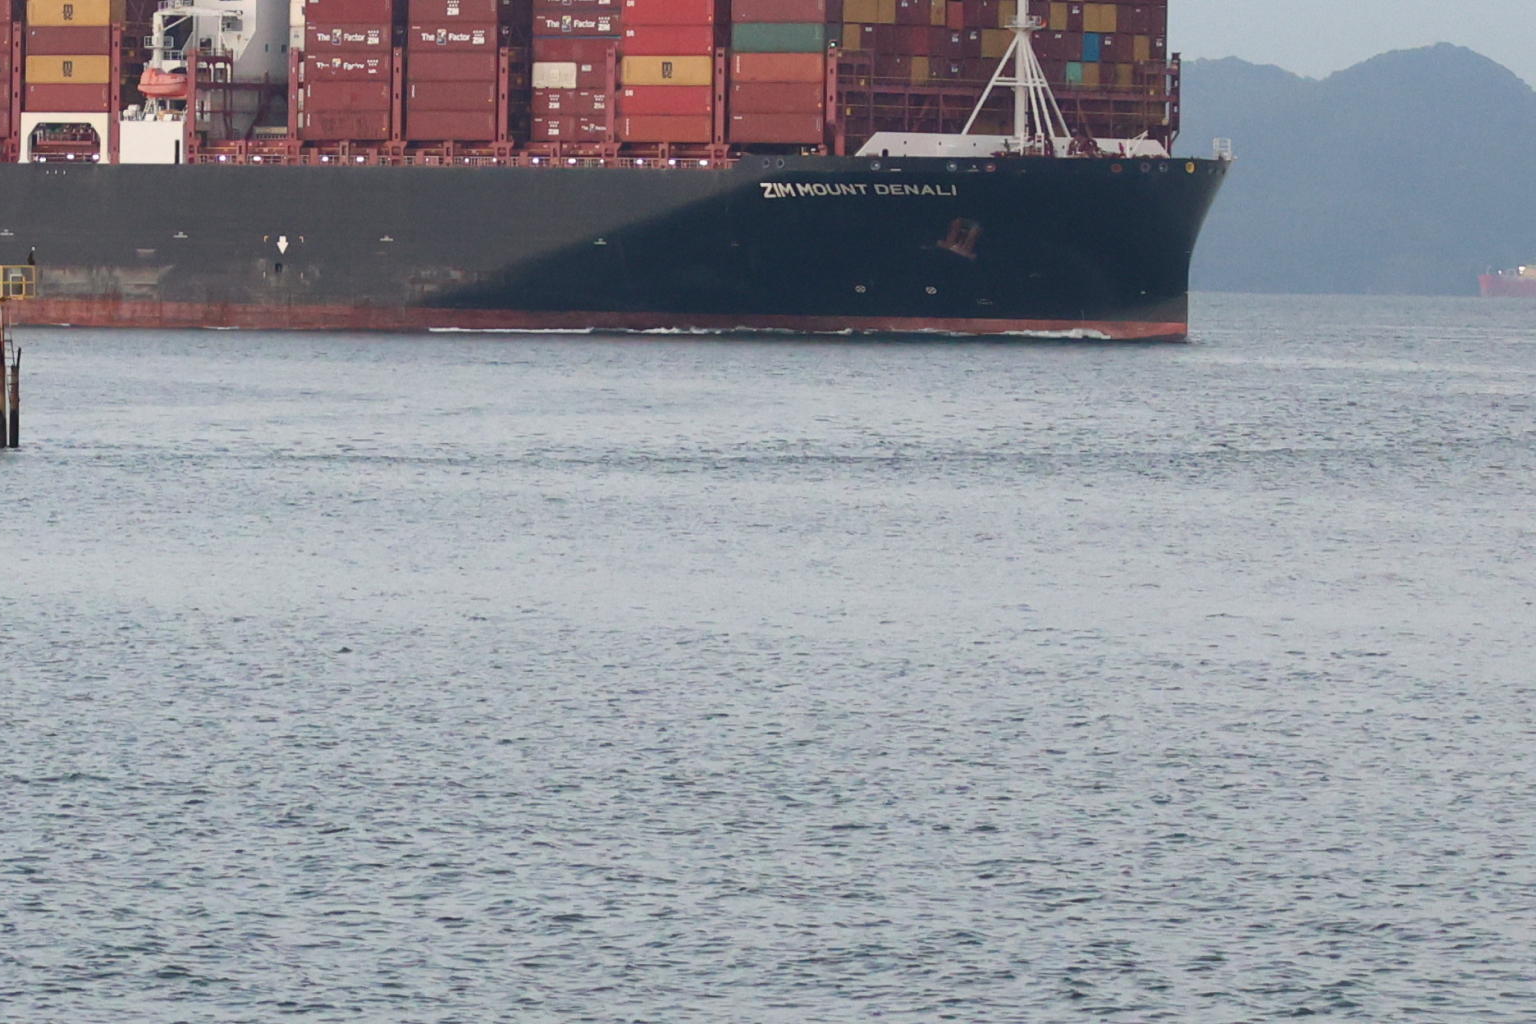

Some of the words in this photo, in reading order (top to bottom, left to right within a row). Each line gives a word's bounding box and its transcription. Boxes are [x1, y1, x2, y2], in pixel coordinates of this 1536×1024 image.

[760, 182, 795, 198] ZIM
[796, 183, 868, 197] MOUNT
[874, 184, 957, 196] DENALI
